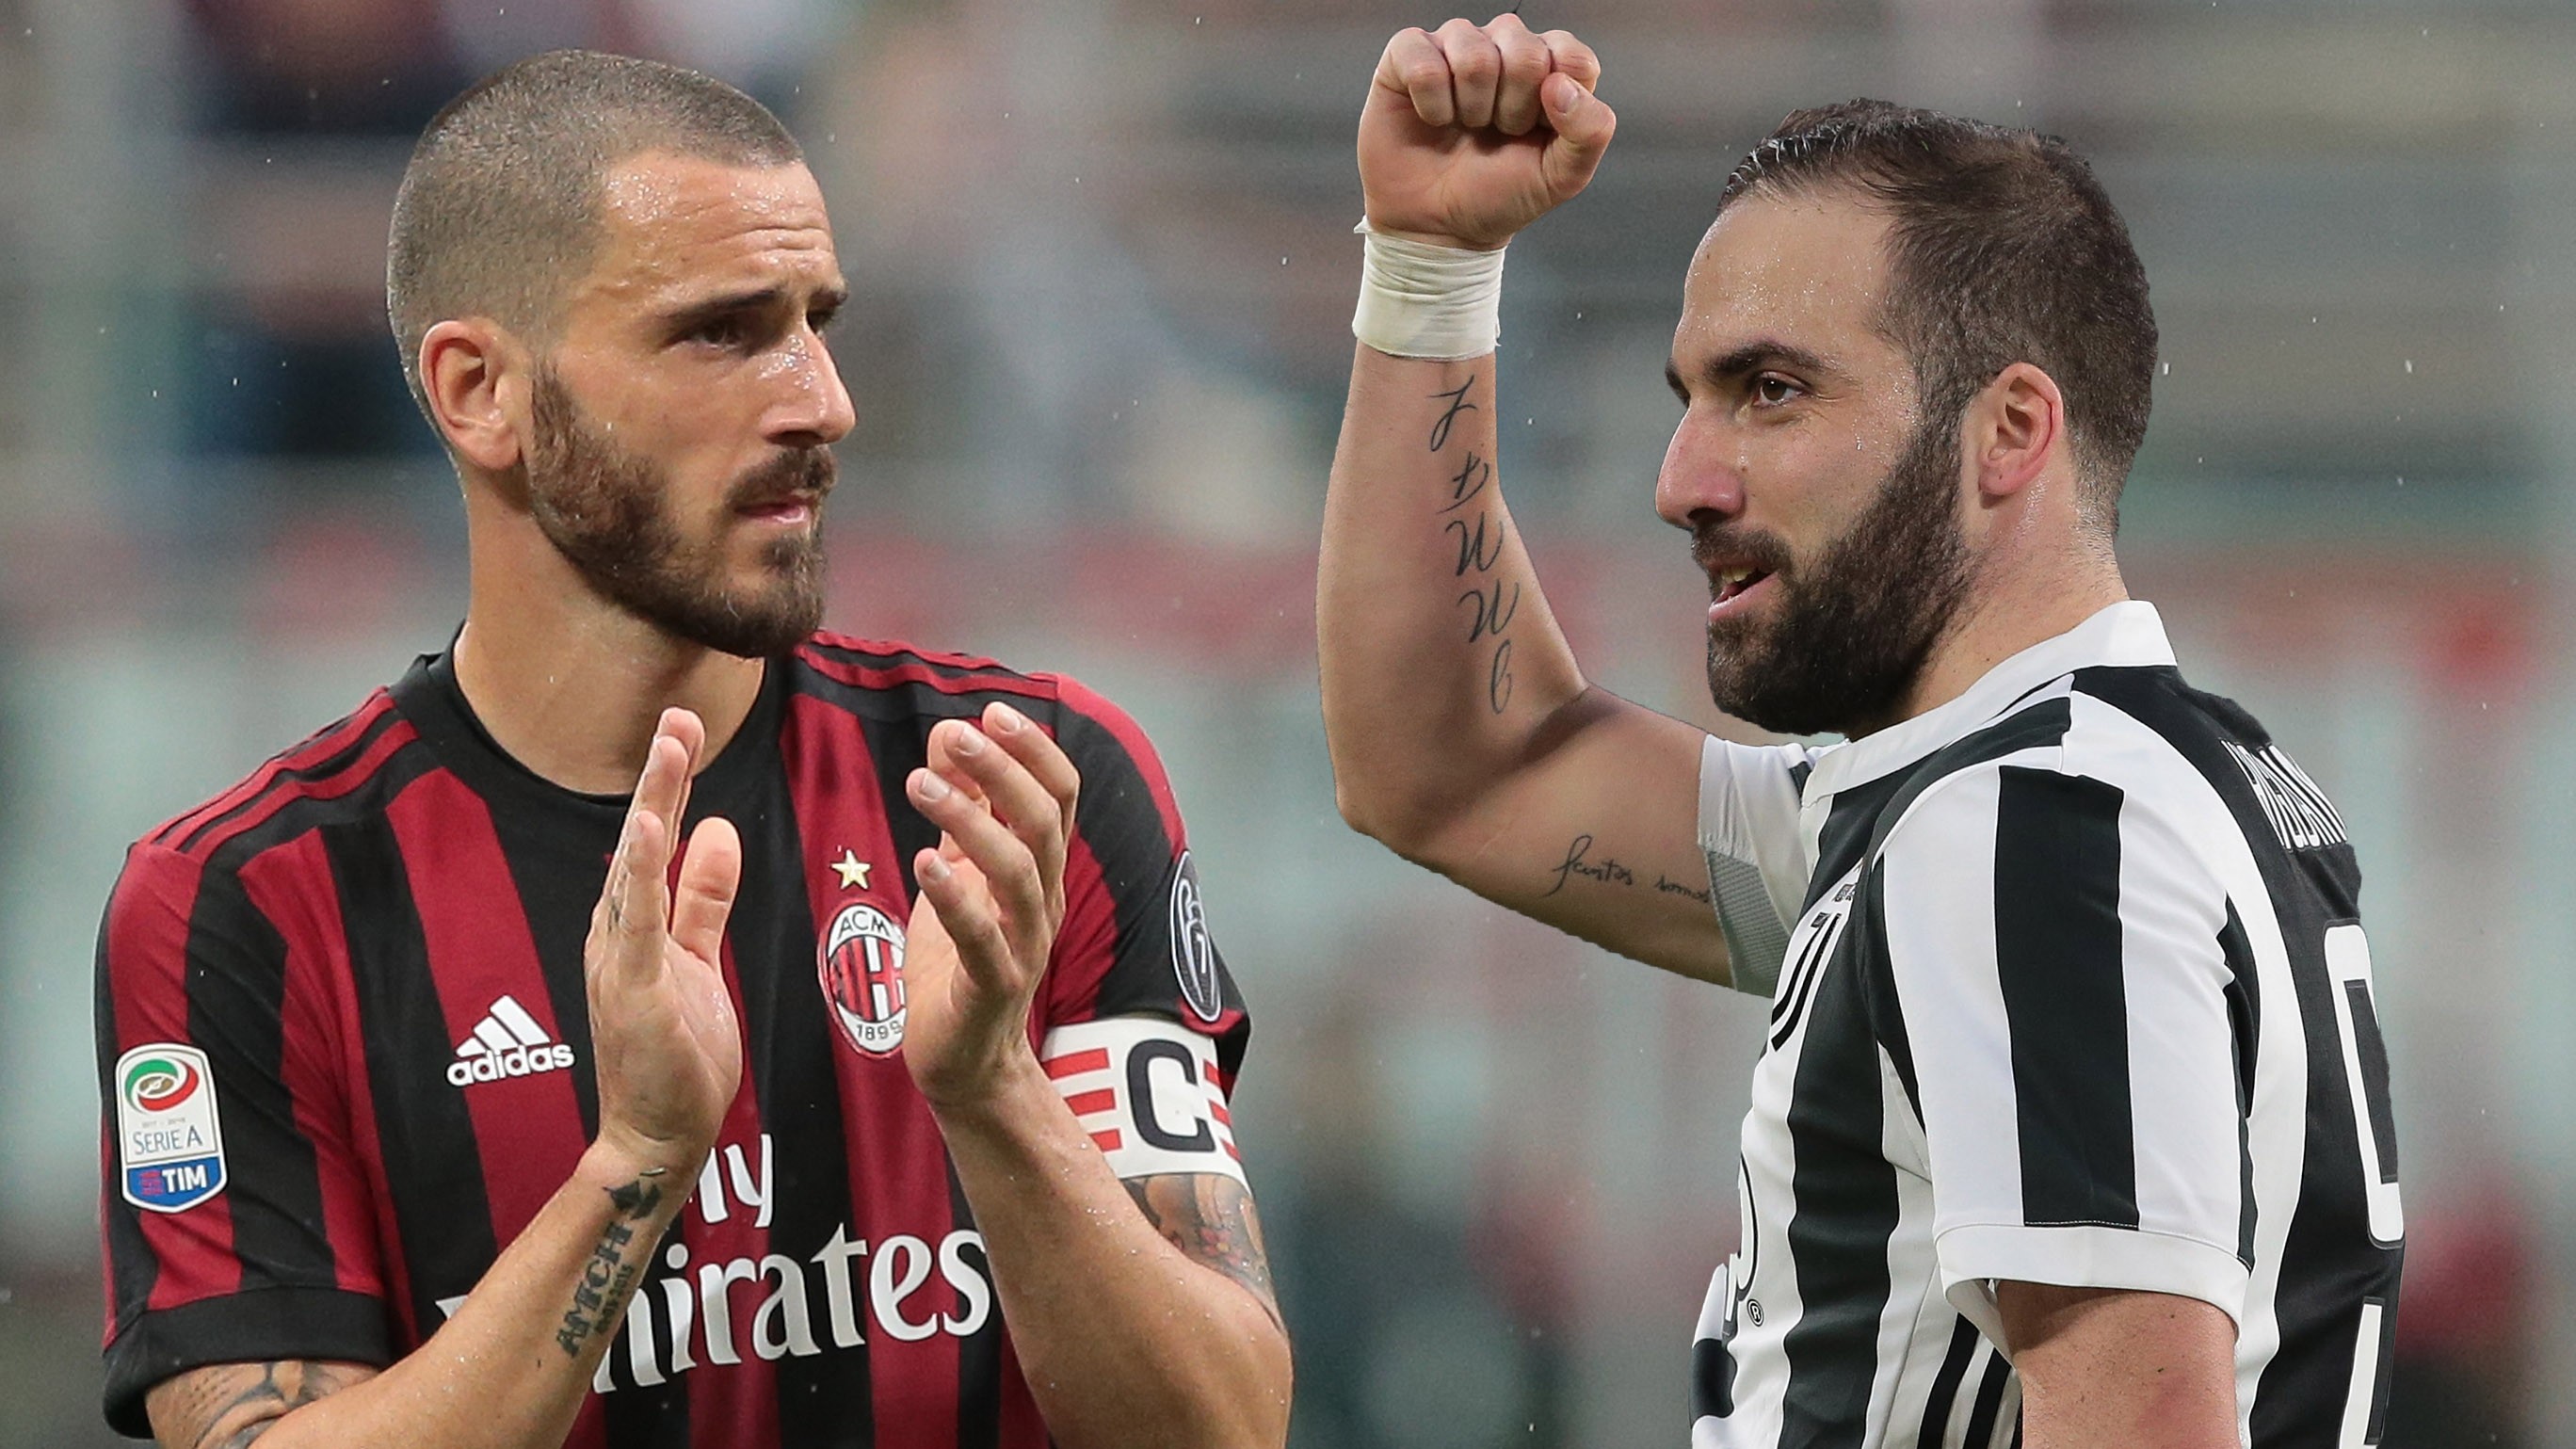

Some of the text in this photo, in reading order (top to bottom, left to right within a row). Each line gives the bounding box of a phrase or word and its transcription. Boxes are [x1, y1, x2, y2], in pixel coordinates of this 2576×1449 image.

[838, 910, 890, 941] ACM
[856, 1021, 904, 1041] 1899
[446, 1044, 575, 1087] adidas
[1127, 1038, 1216, 1152] C
[133, 1125, 202, 1155] SERIE A
[162, 1165, 207, 1193] TIM
[698, 1134, 774, 1228] ly
[436, 1223, 990, 1393] irates
